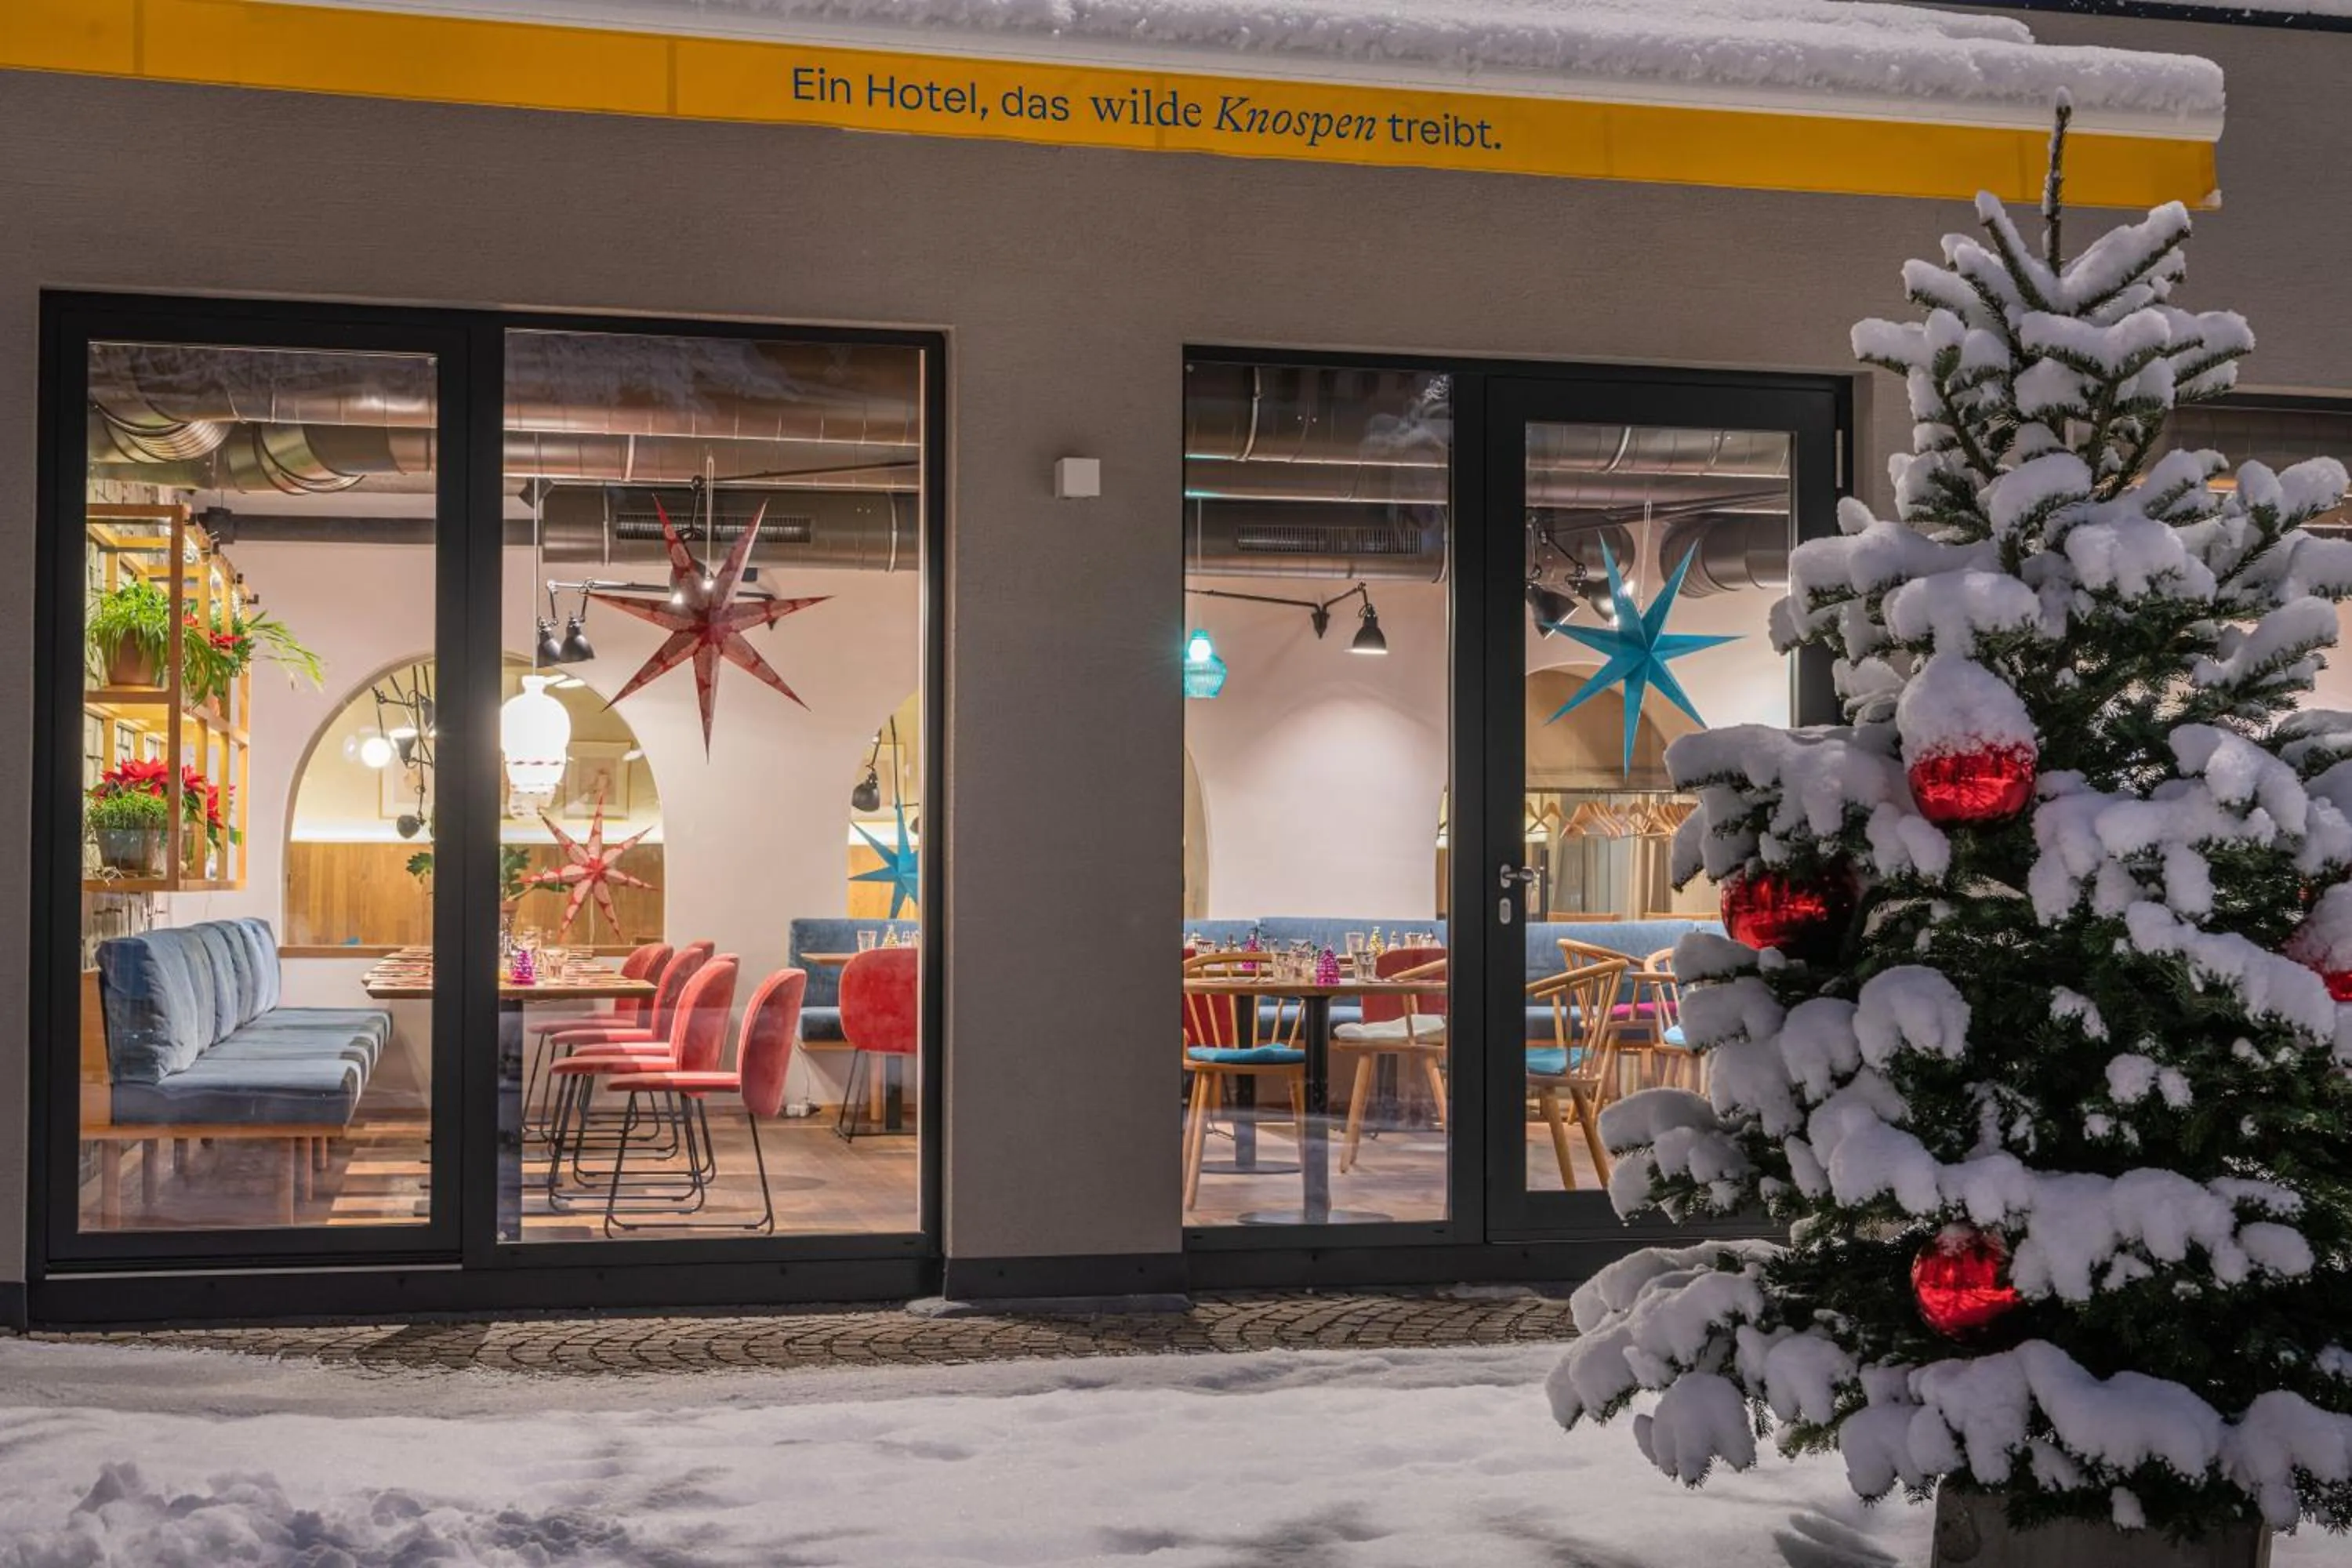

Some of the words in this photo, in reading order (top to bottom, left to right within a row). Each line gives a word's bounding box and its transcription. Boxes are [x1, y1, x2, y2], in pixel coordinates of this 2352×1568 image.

[793, 67, 851, 103] Ein
[868, 74, 989, 121] Hotel,
[1001, 85, 1070, 122] das
[1090, 87, 1202, 128] wilde
[1214, 96, 1377, 147] Knospen
[1386, 112, 1502, 151] treibt.
